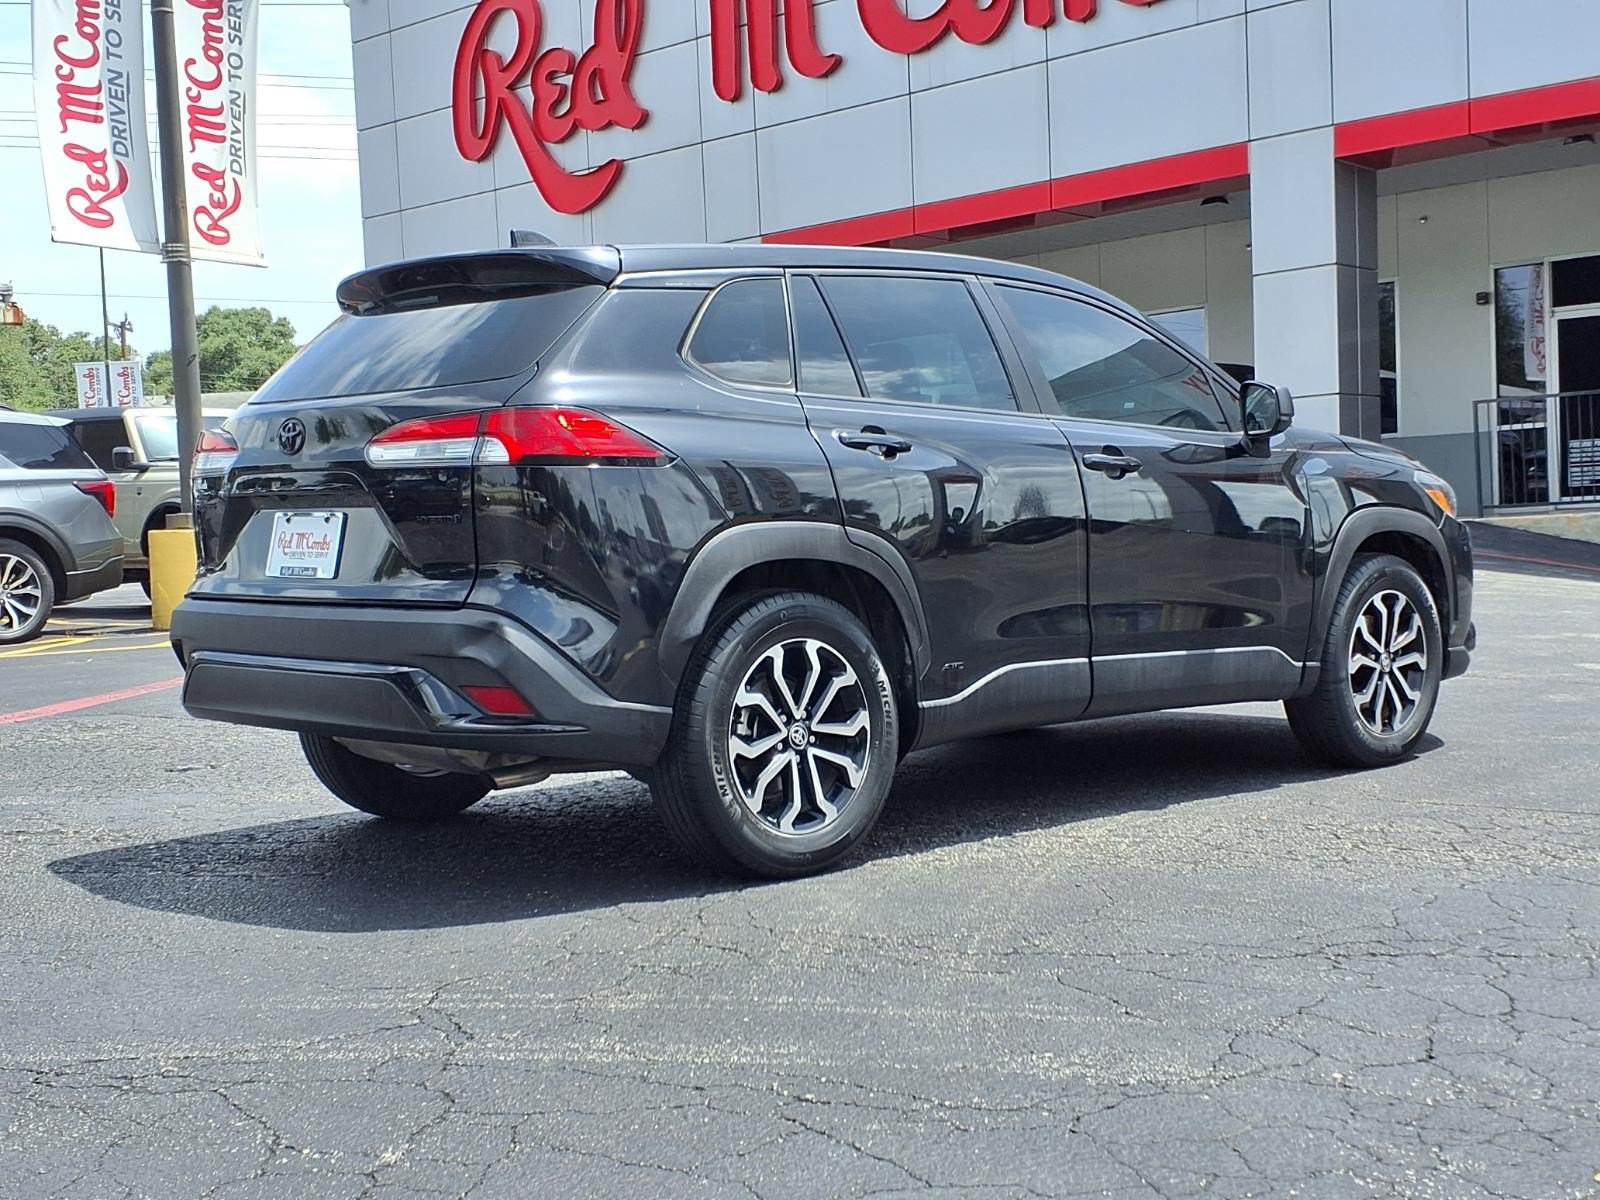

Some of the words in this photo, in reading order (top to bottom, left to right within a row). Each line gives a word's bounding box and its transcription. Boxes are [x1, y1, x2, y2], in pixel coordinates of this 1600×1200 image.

[105, 28, 123, 61] TO
[227, 0, 243, 46] SER
[184, 0, 227, 154] McCom
[227, 52, 243, 82] TO
[452, 0, 649, 215] Red
[106, 68, 129, 159] DRIVEN
[228, 89, 244, 177] DRIVEN
[63, 142, 129, 229] Red
[191, 162, 242, 246] Red
[277, 530, 294, 556] Red
[295, 532, 332, 550] McCombs
[288, 550, 306, 558] DRIVEN
[314, 551, 329, 559] SERVE
